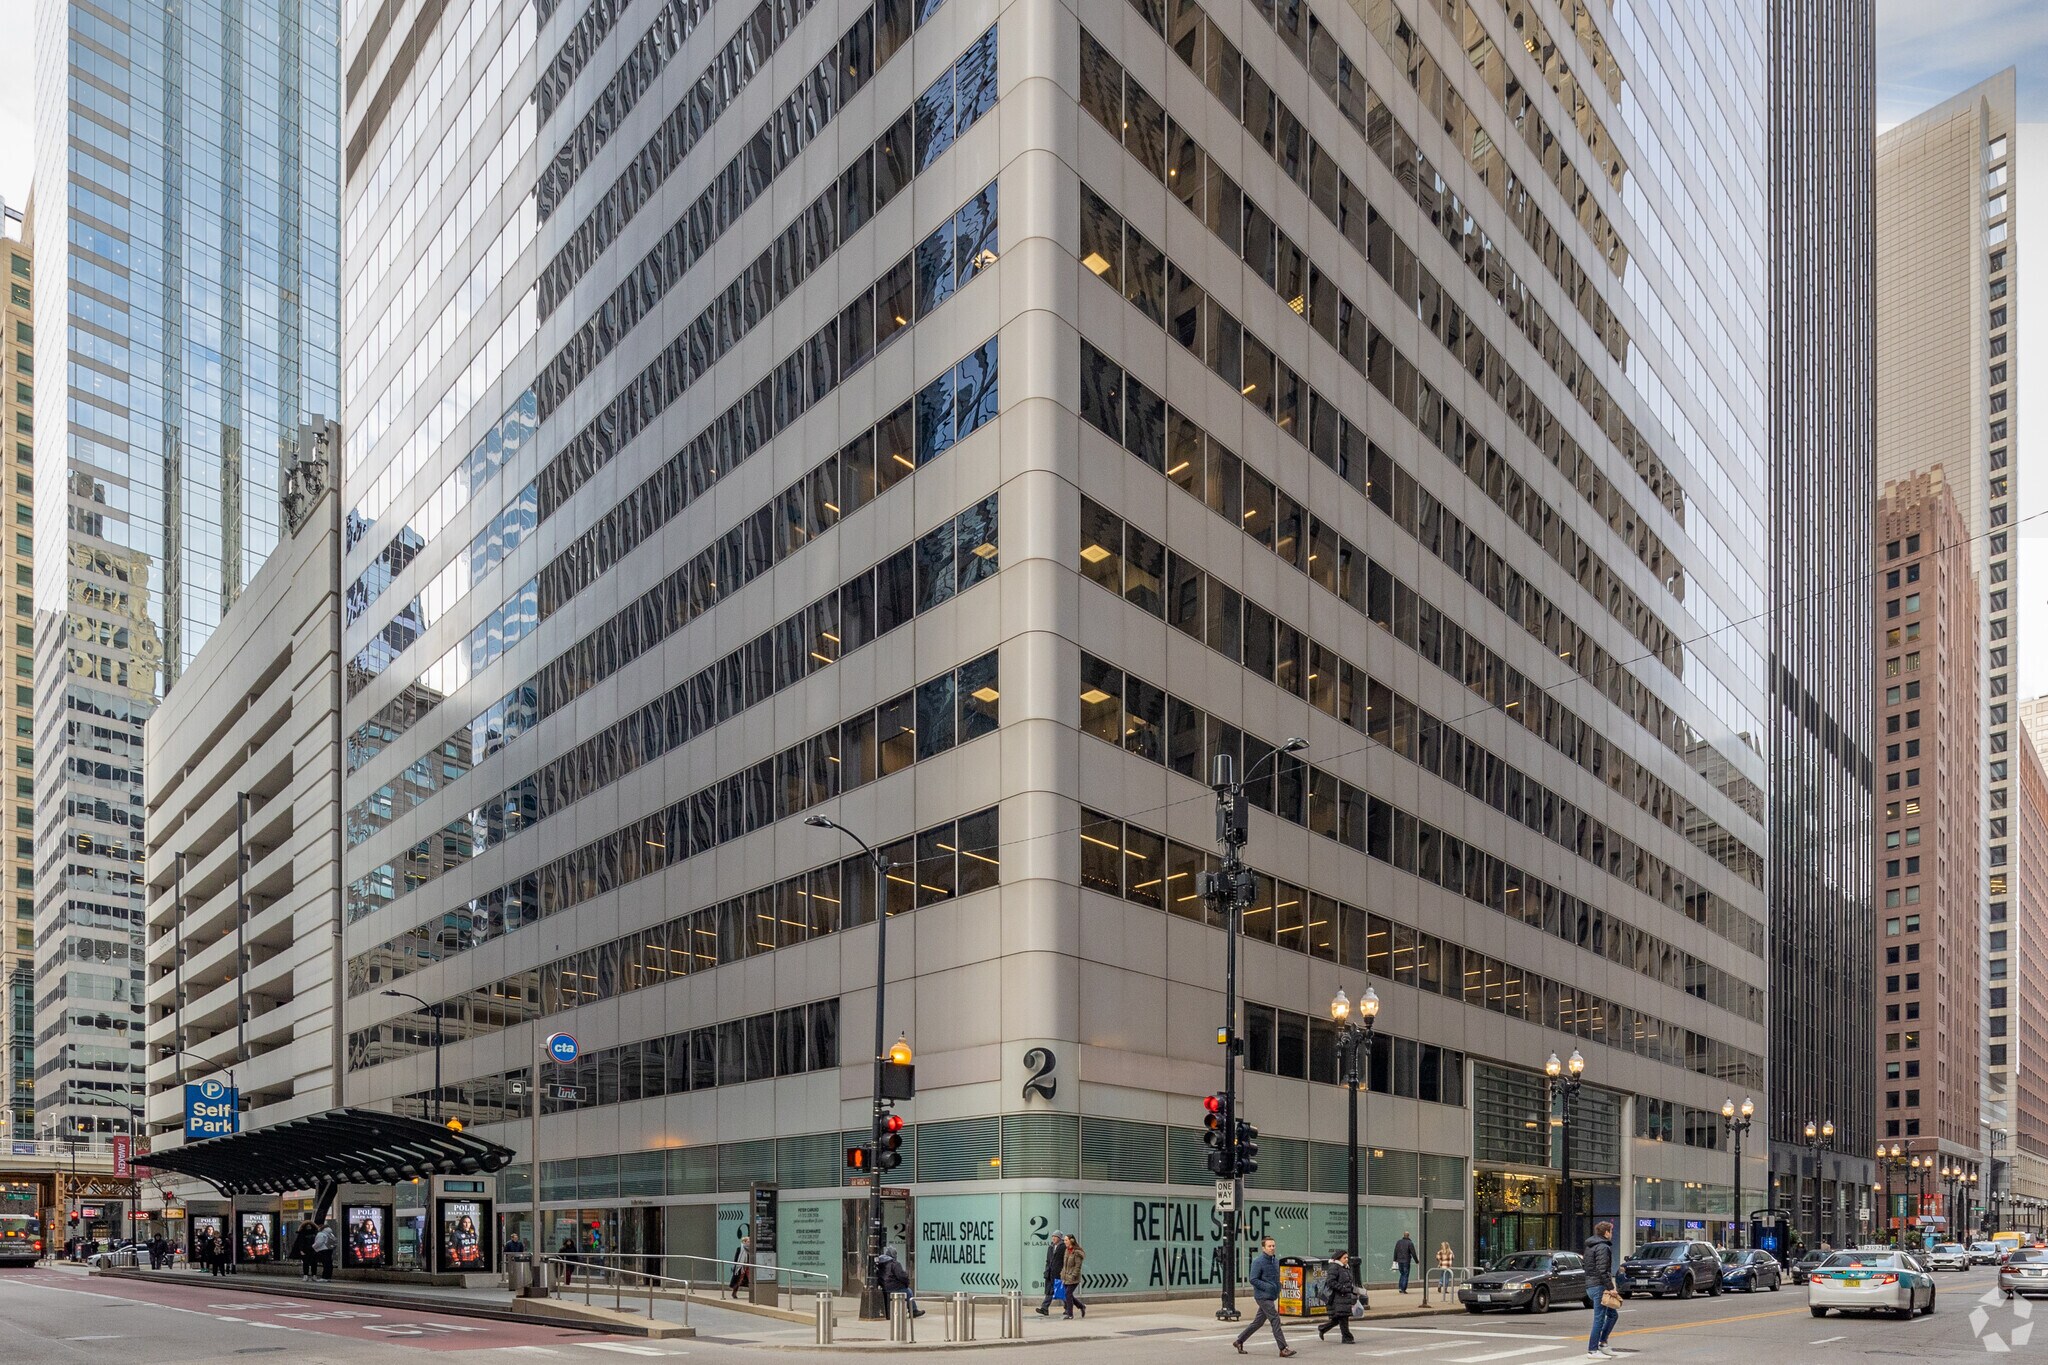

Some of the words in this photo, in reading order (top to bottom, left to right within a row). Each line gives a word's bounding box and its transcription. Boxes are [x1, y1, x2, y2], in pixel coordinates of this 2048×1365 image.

[554, 1043, 574, 1053] cta
[1022, 1047, 1056, 1100] 2
[206, 1082, 219, 1096] P
[558, 1086, 577, 1099] Link
[193, 1102, 231, 1117] Self
[190, 1118, 232, 1133] Park
[118, 1142, 126, 1173] AWAKEN
[1217, 1182, 1232, 1190] ONE
[1217, 1191, 1233, 1199] WAY
[1029, 1215, 1050, 1241] 2
[1133, 1201, 1204, 1241] RETAIL
[1210, 1204, 1271, 1241] SACE
[1639, 1219, 1652, 1227] CHASE
[1686, 1221, 1698, 1229] CHASE
[922, 1222, 957, 1241] RETAIL
[960, 1221, 994, 1241] SPACE
[929, 1244, 986, 1264] AVAILABLE
[1149, 1246, 1259, 1287] AVAILAL
[1282, 1280, 1299, 1289] FINAL
[1280, 1289, 1301, 1299] WEEKS
[274, 1310, 383, 1321] BUS
[362, 1322, 491, 1336] CTA
